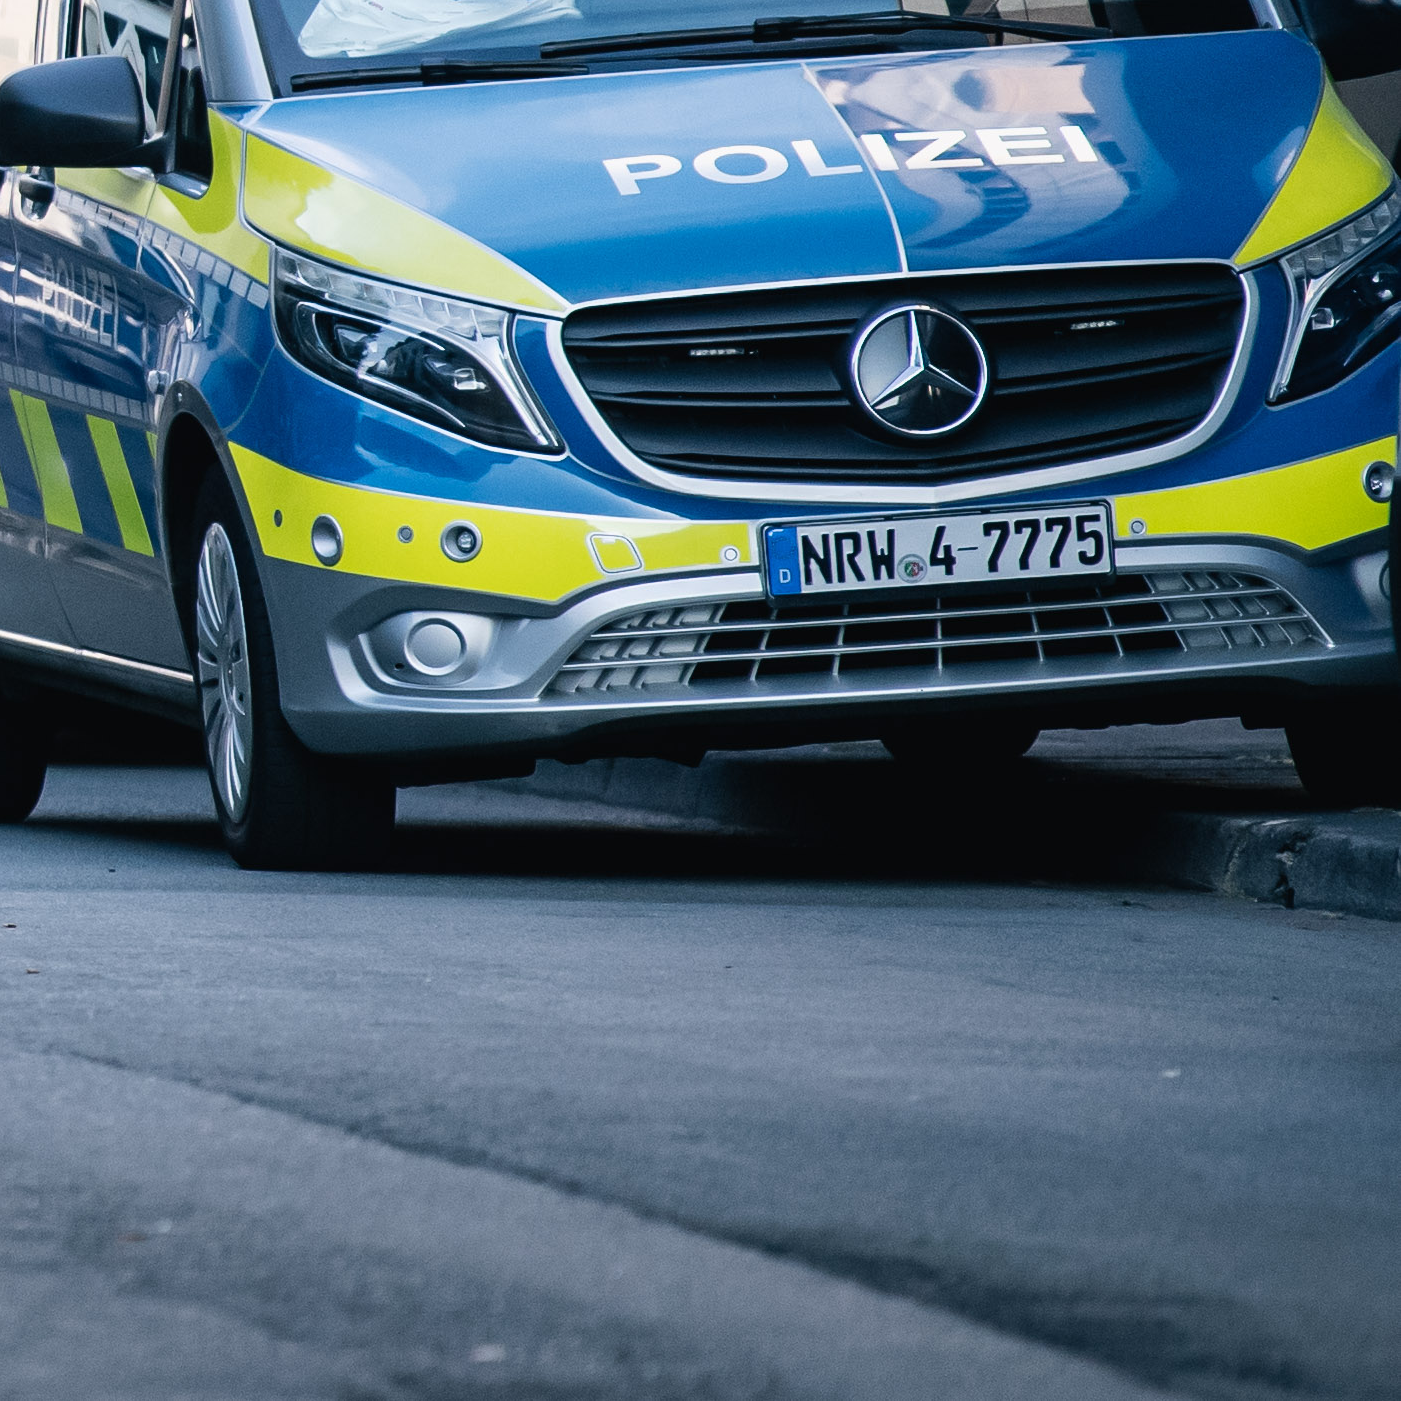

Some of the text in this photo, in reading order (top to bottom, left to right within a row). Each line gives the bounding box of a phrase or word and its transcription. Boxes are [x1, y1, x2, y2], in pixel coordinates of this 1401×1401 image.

[602, 125, 1100, 196] POLIZEI
[42, 253, 119, 351] POLIZEI
[779, 568, 792, 584] D
[800, 528, 897, 586] NRW
